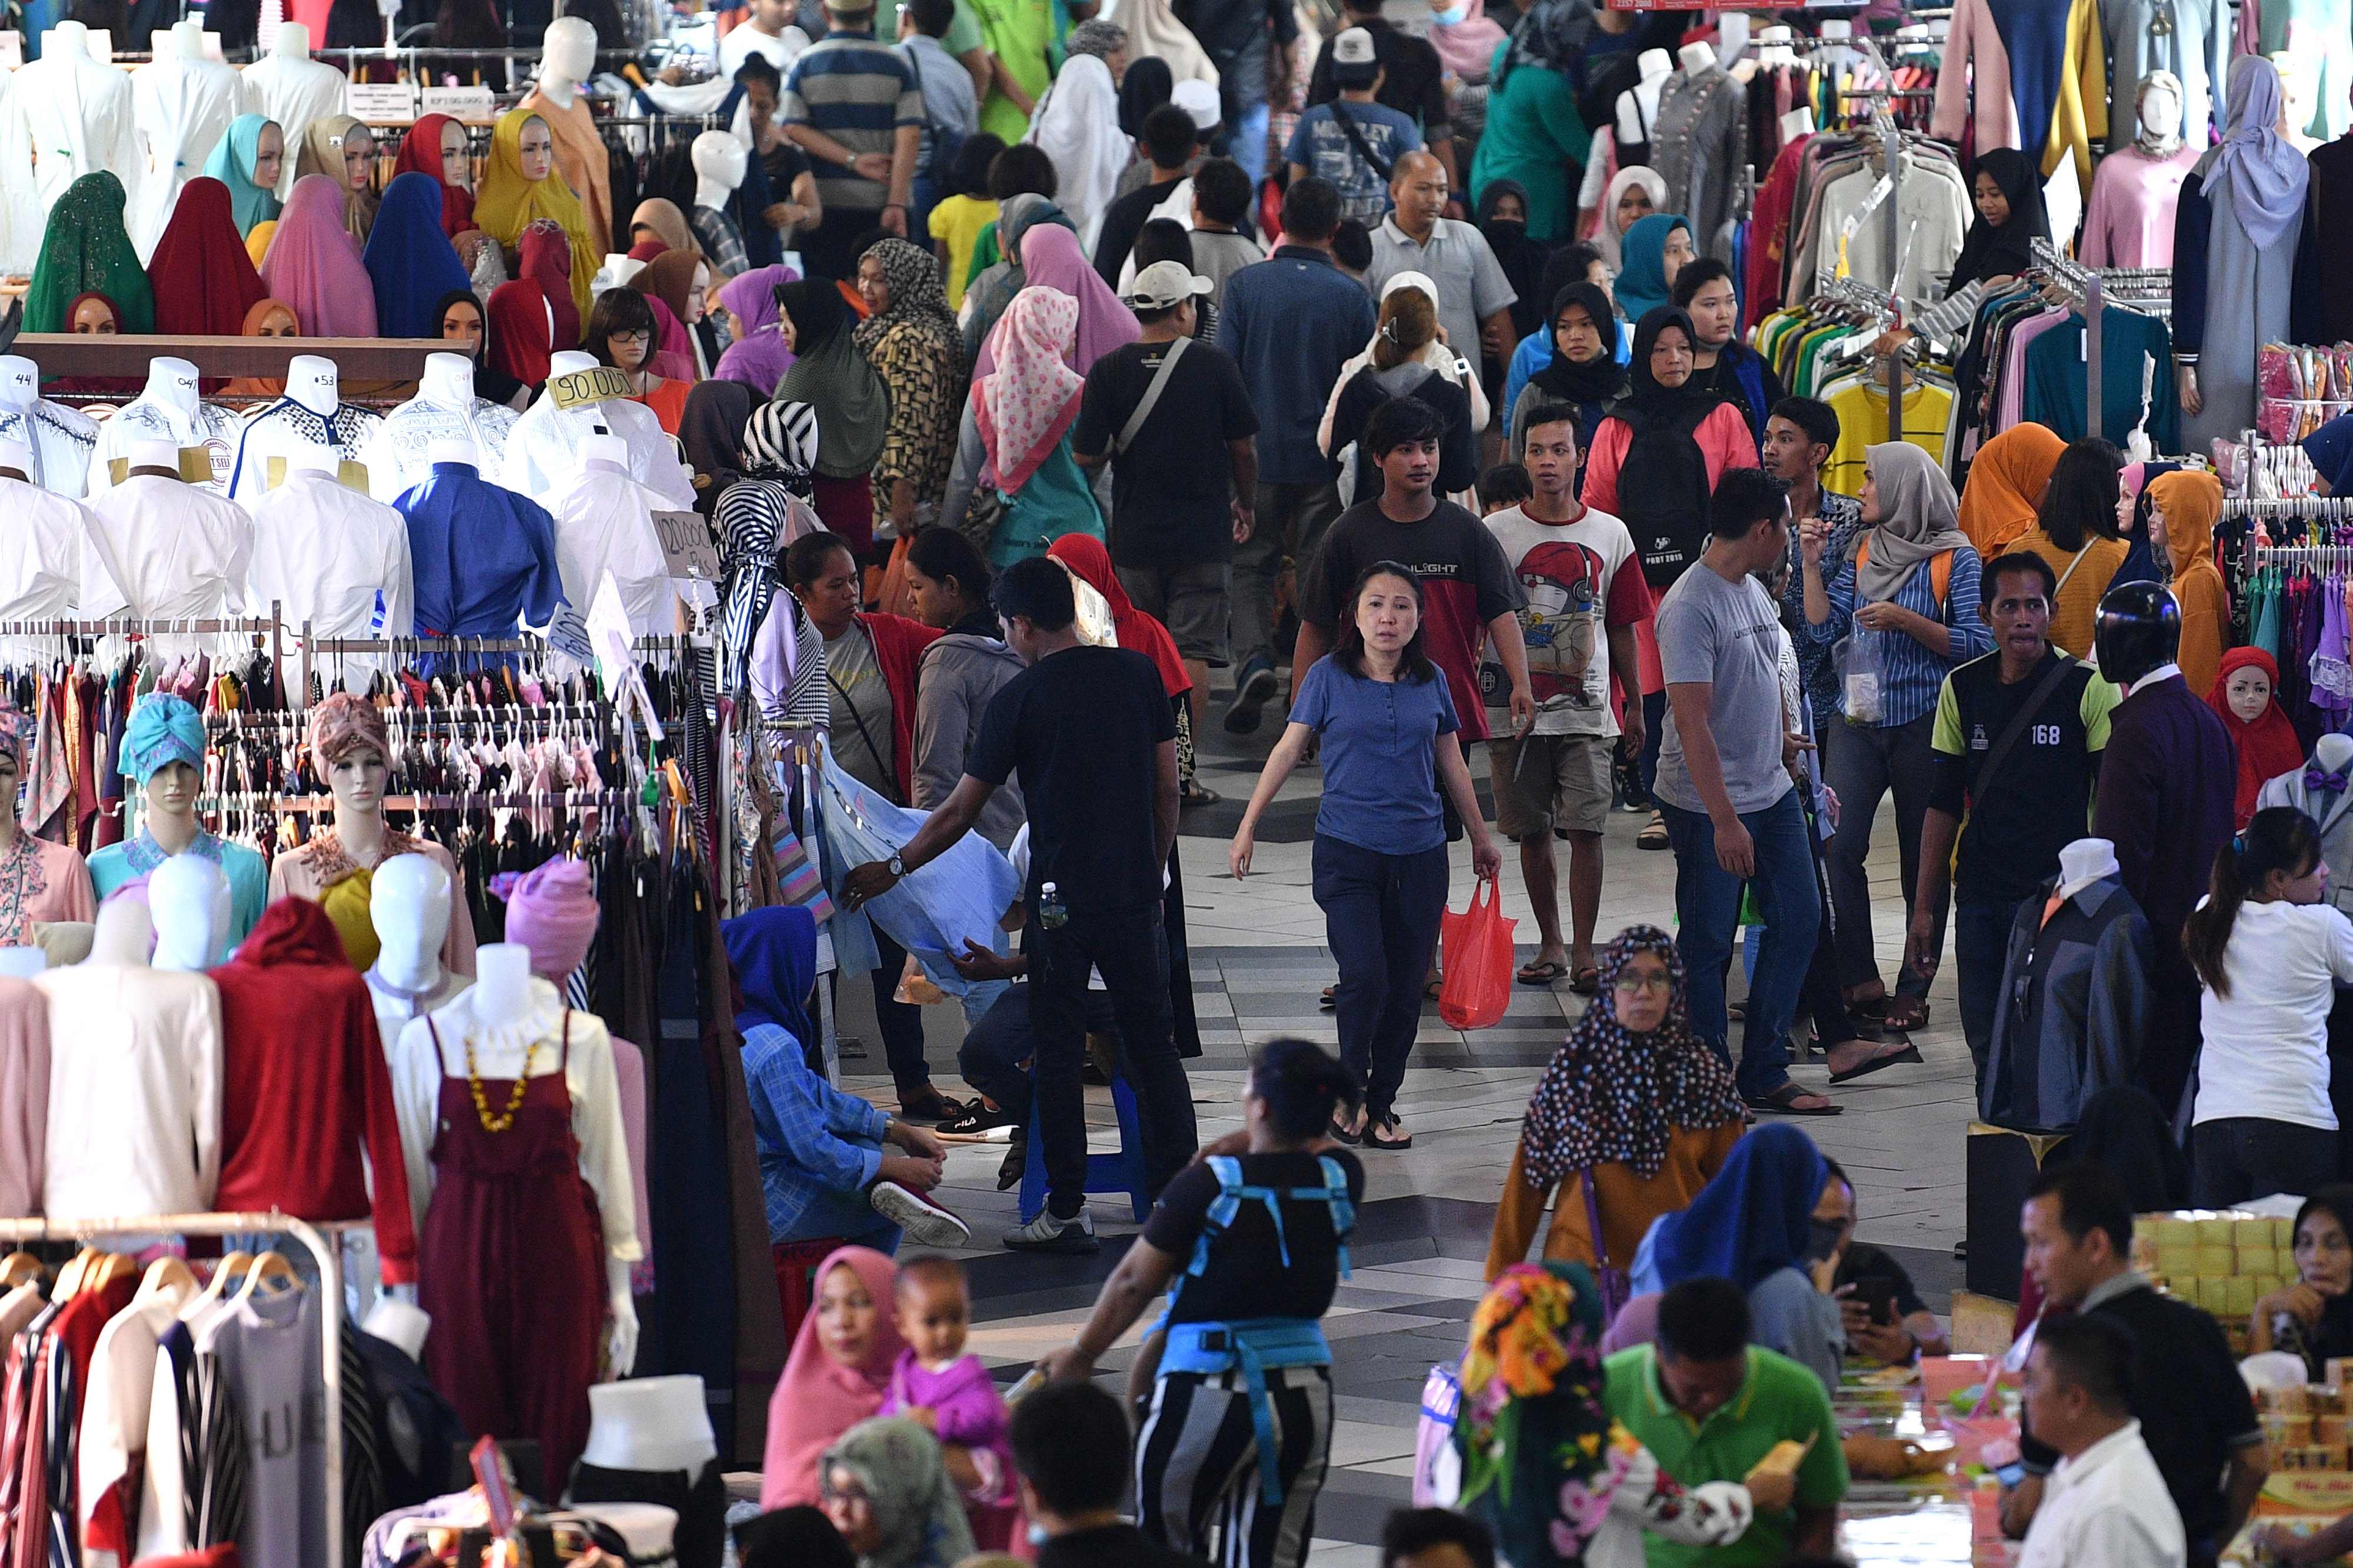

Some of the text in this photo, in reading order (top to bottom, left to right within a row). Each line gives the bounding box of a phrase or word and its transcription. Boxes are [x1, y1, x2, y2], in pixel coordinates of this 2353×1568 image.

[558, 370, 633, 402] 90.000
[658, 518, 711, 555] 120.000
[2032, 725, 2060, 745] 168
